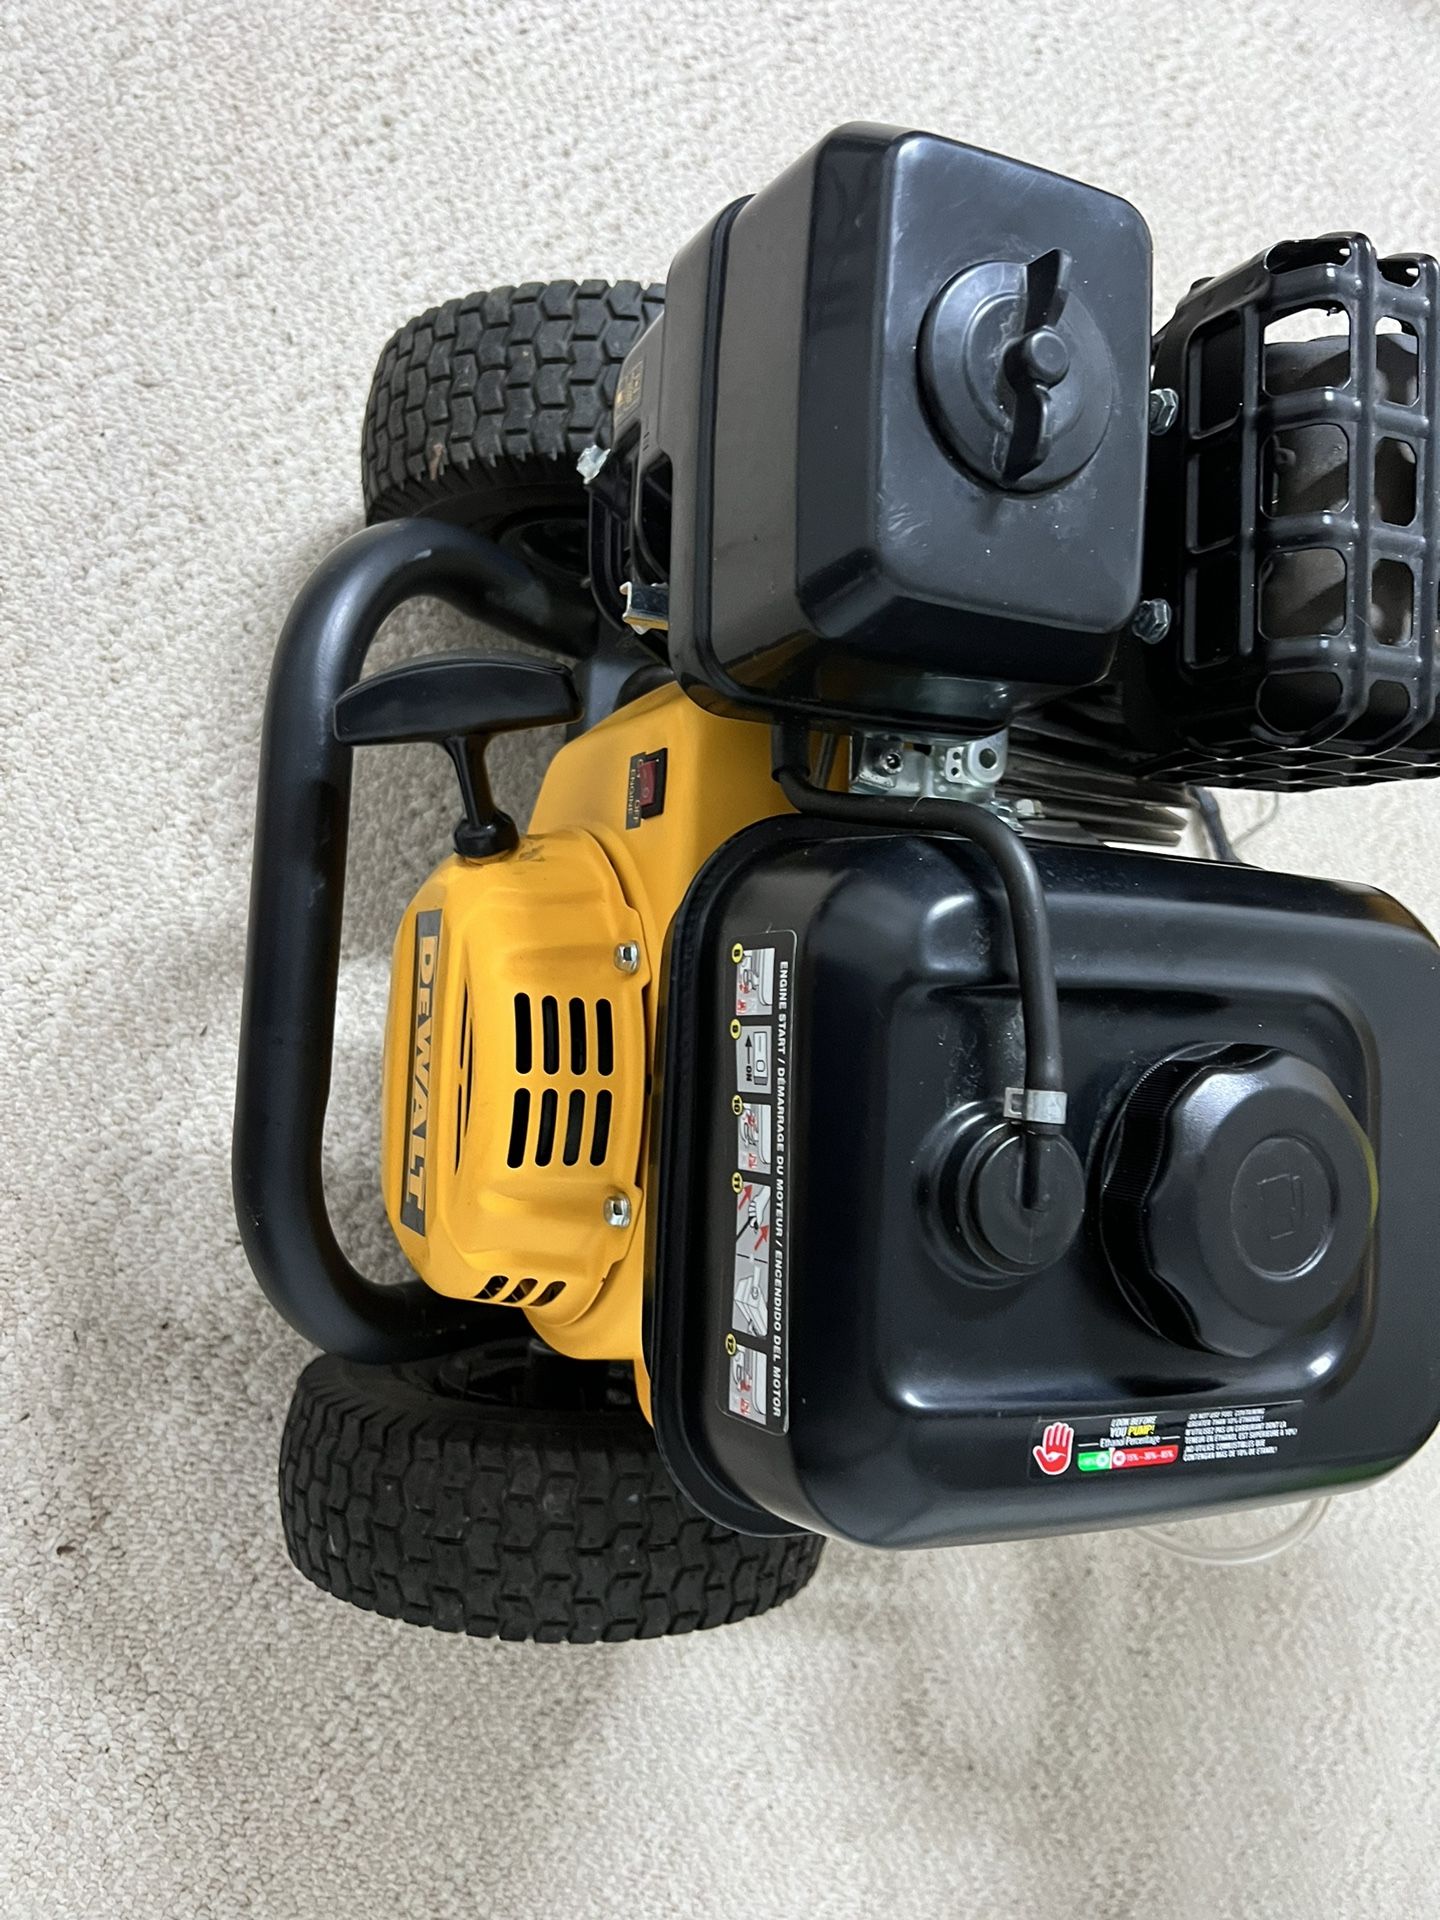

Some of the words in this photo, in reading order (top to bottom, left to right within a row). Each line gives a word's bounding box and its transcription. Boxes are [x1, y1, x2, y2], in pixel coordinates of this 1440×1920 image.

[628, 769, 636, 815] ENGINE
[778, 961, 788, 1010] ENGINE
[778, 1013, 787, 1054] START
[405, 935, 438, 1212] DEWALT
[745, 1064, 753, 1082] ON
[776, 1067, 787, 1152] DÉMARRAGE
[776, 1155, 784, 1175] DU
[775, 1178, 784, 1237] MOTEUR
[773, 1249, 783, 1332] ENCENDIDO
[773, 1334, 782, 1363] DEL
[772, 1365, 781, 1418] MOTOR
[1110, 1426, 1127, 1437] YOU
[1127, 1424, 1156, 1436] PUMP!
